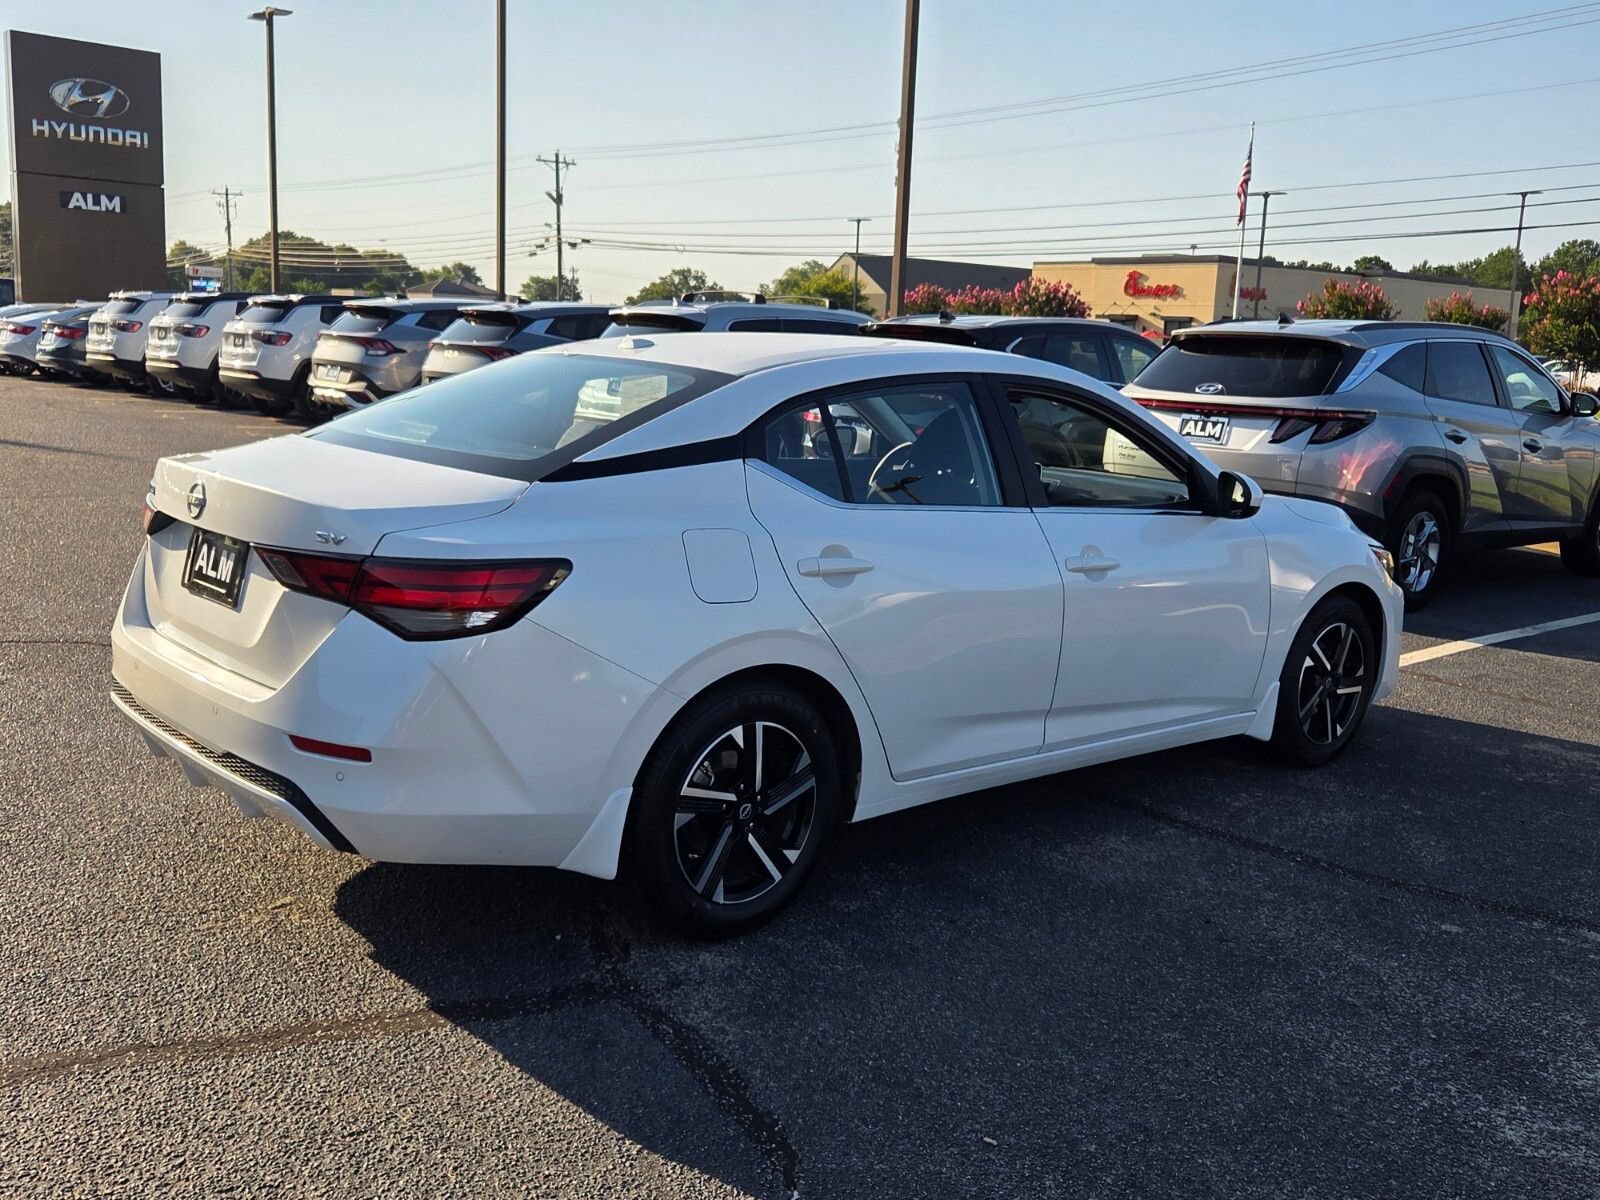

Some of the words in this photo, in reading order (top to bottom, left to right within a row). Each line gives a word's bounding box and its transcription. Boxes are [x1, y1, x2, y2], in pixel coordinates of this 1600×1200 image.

[31, 118, 149, 149] HYUNDAI
[67, 192, 121, 213] ALM
[1181, 420, 1223, 438] ALM
[315, 530, 348, 545] SV
[194, 542, 235, 583] ALM
